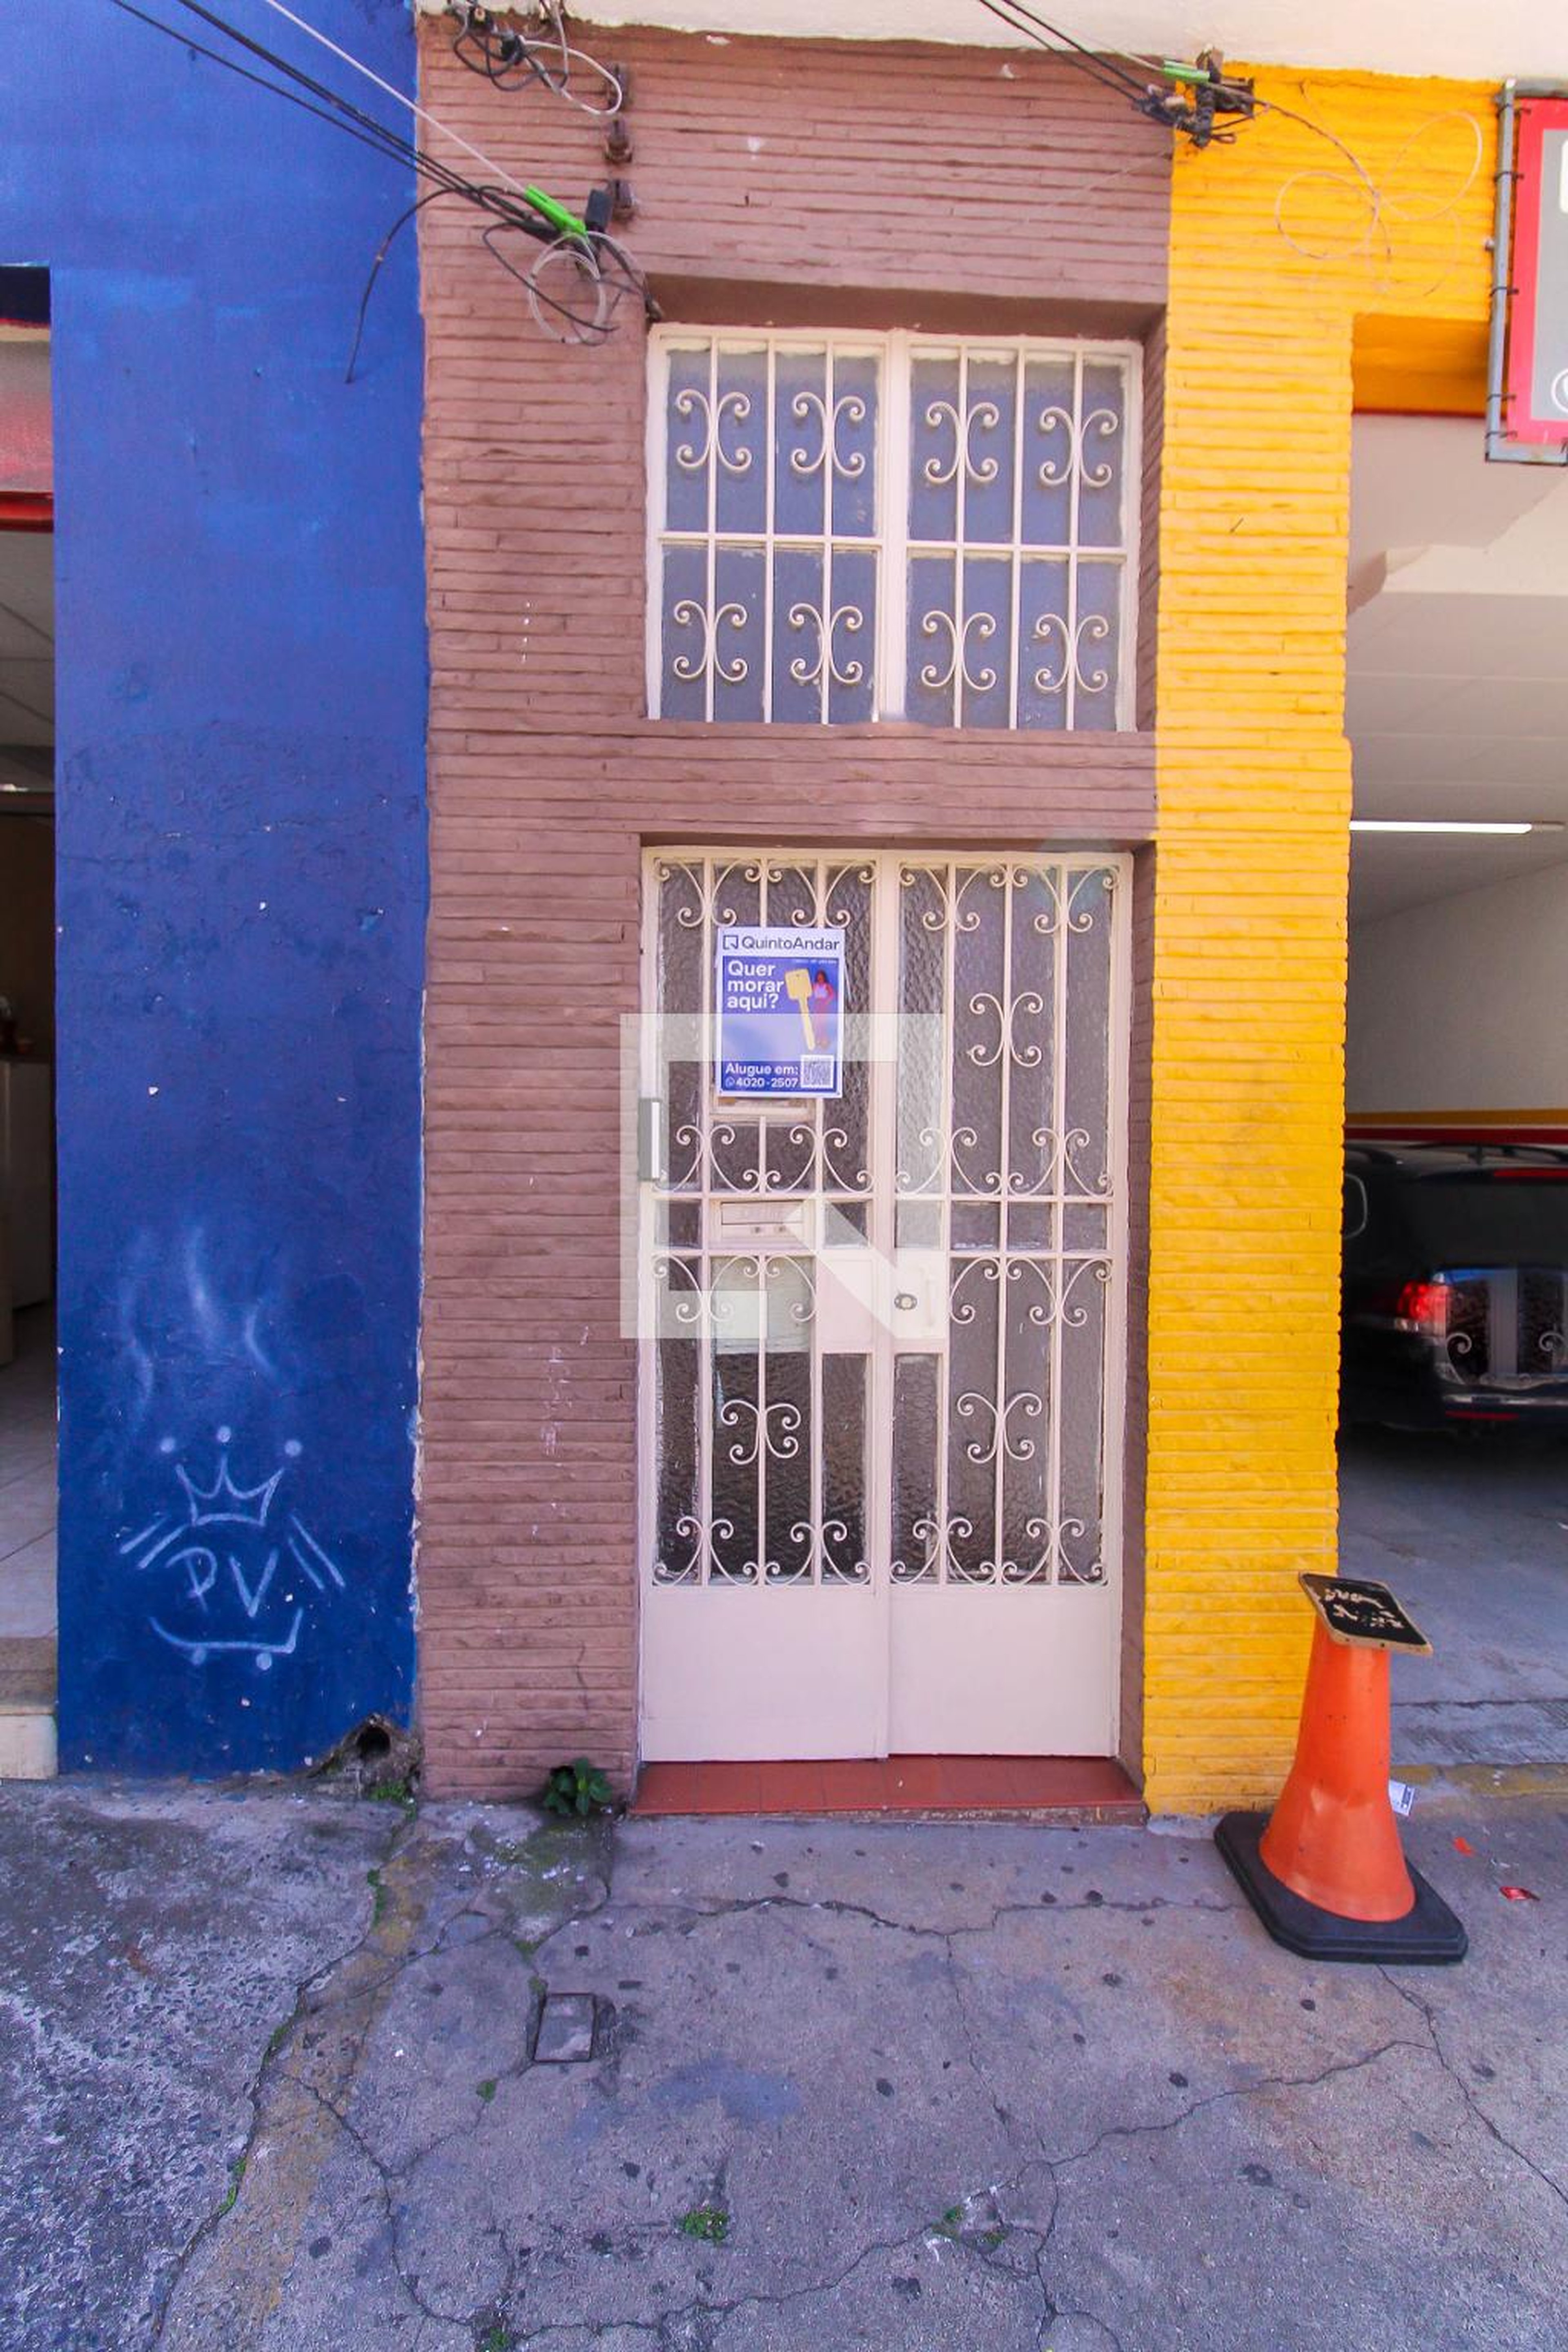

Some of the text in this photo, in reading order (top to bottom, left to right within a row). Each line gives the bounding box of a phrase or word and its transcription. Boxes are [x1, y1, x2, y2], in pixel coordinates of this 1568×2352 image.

[742, 935, 840, 950] QuintoAndar
[728, 961, 775, 977] Quer
[728, 980, 784, 992] morar
[727, 994, 779, 1011] aqui?
[726, 1063, 798, 1077] Alugue em:
